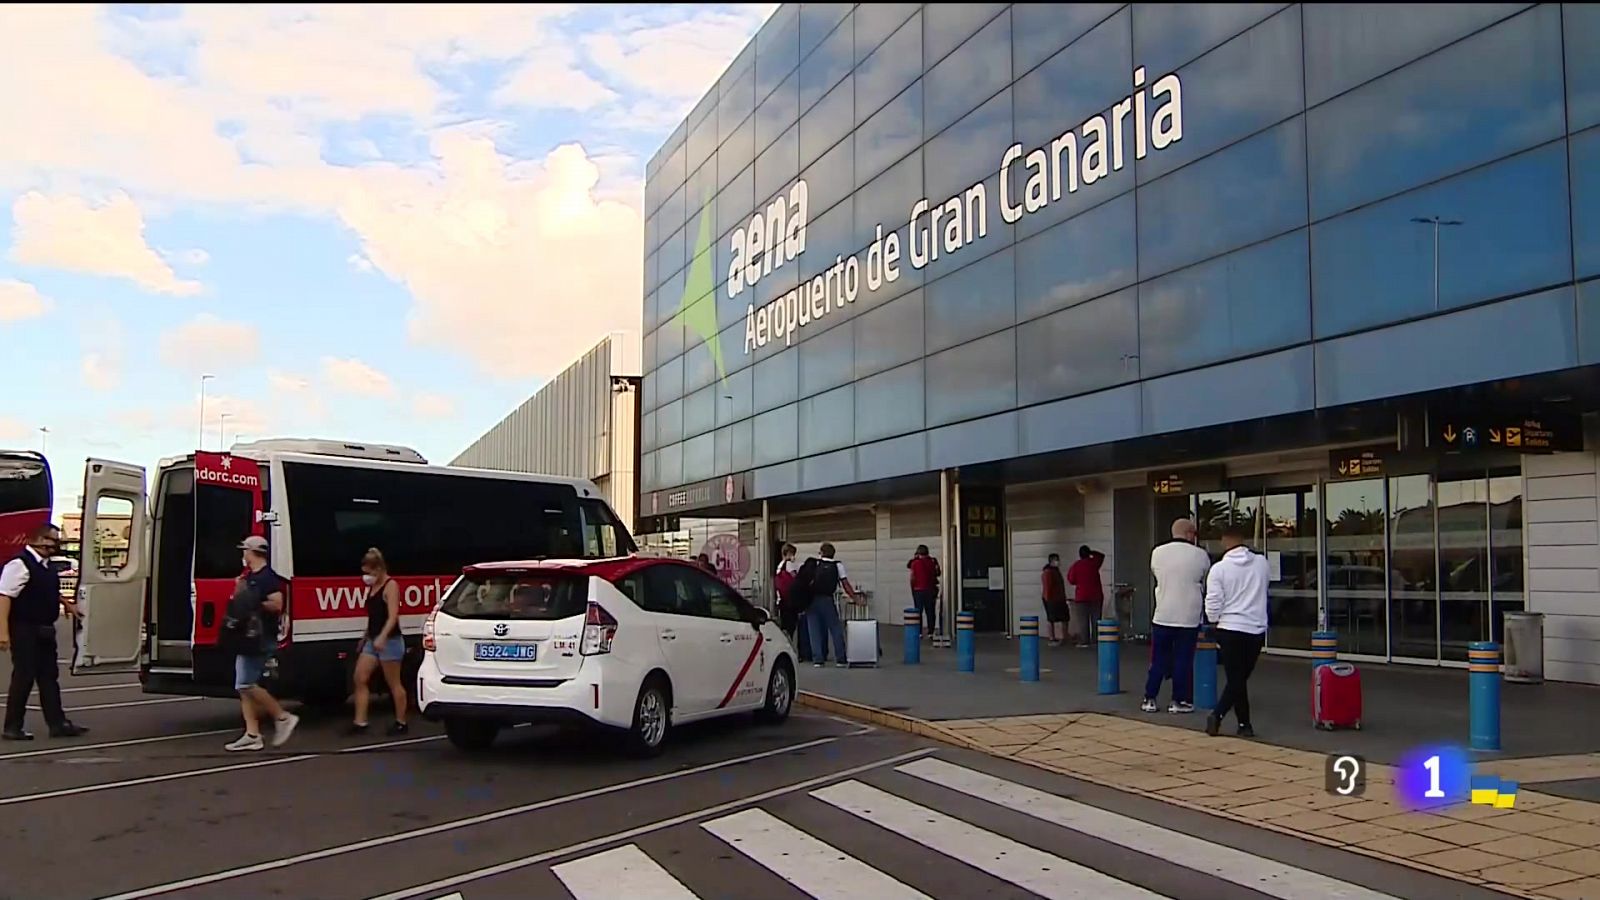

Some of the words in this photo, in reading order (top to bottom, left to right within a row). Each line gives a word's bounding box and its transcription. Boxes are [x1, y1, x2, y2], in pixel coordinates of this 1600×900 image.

[727, 179, 808, 298] aena
[744, 253, 860, 355] Aeropuerto
[866, 224, 900, 292] de
[909, 182, 987, 270] Gran
[999, 65, 1184, 225] Canaria
[481, 645, 509, 658] 6924
